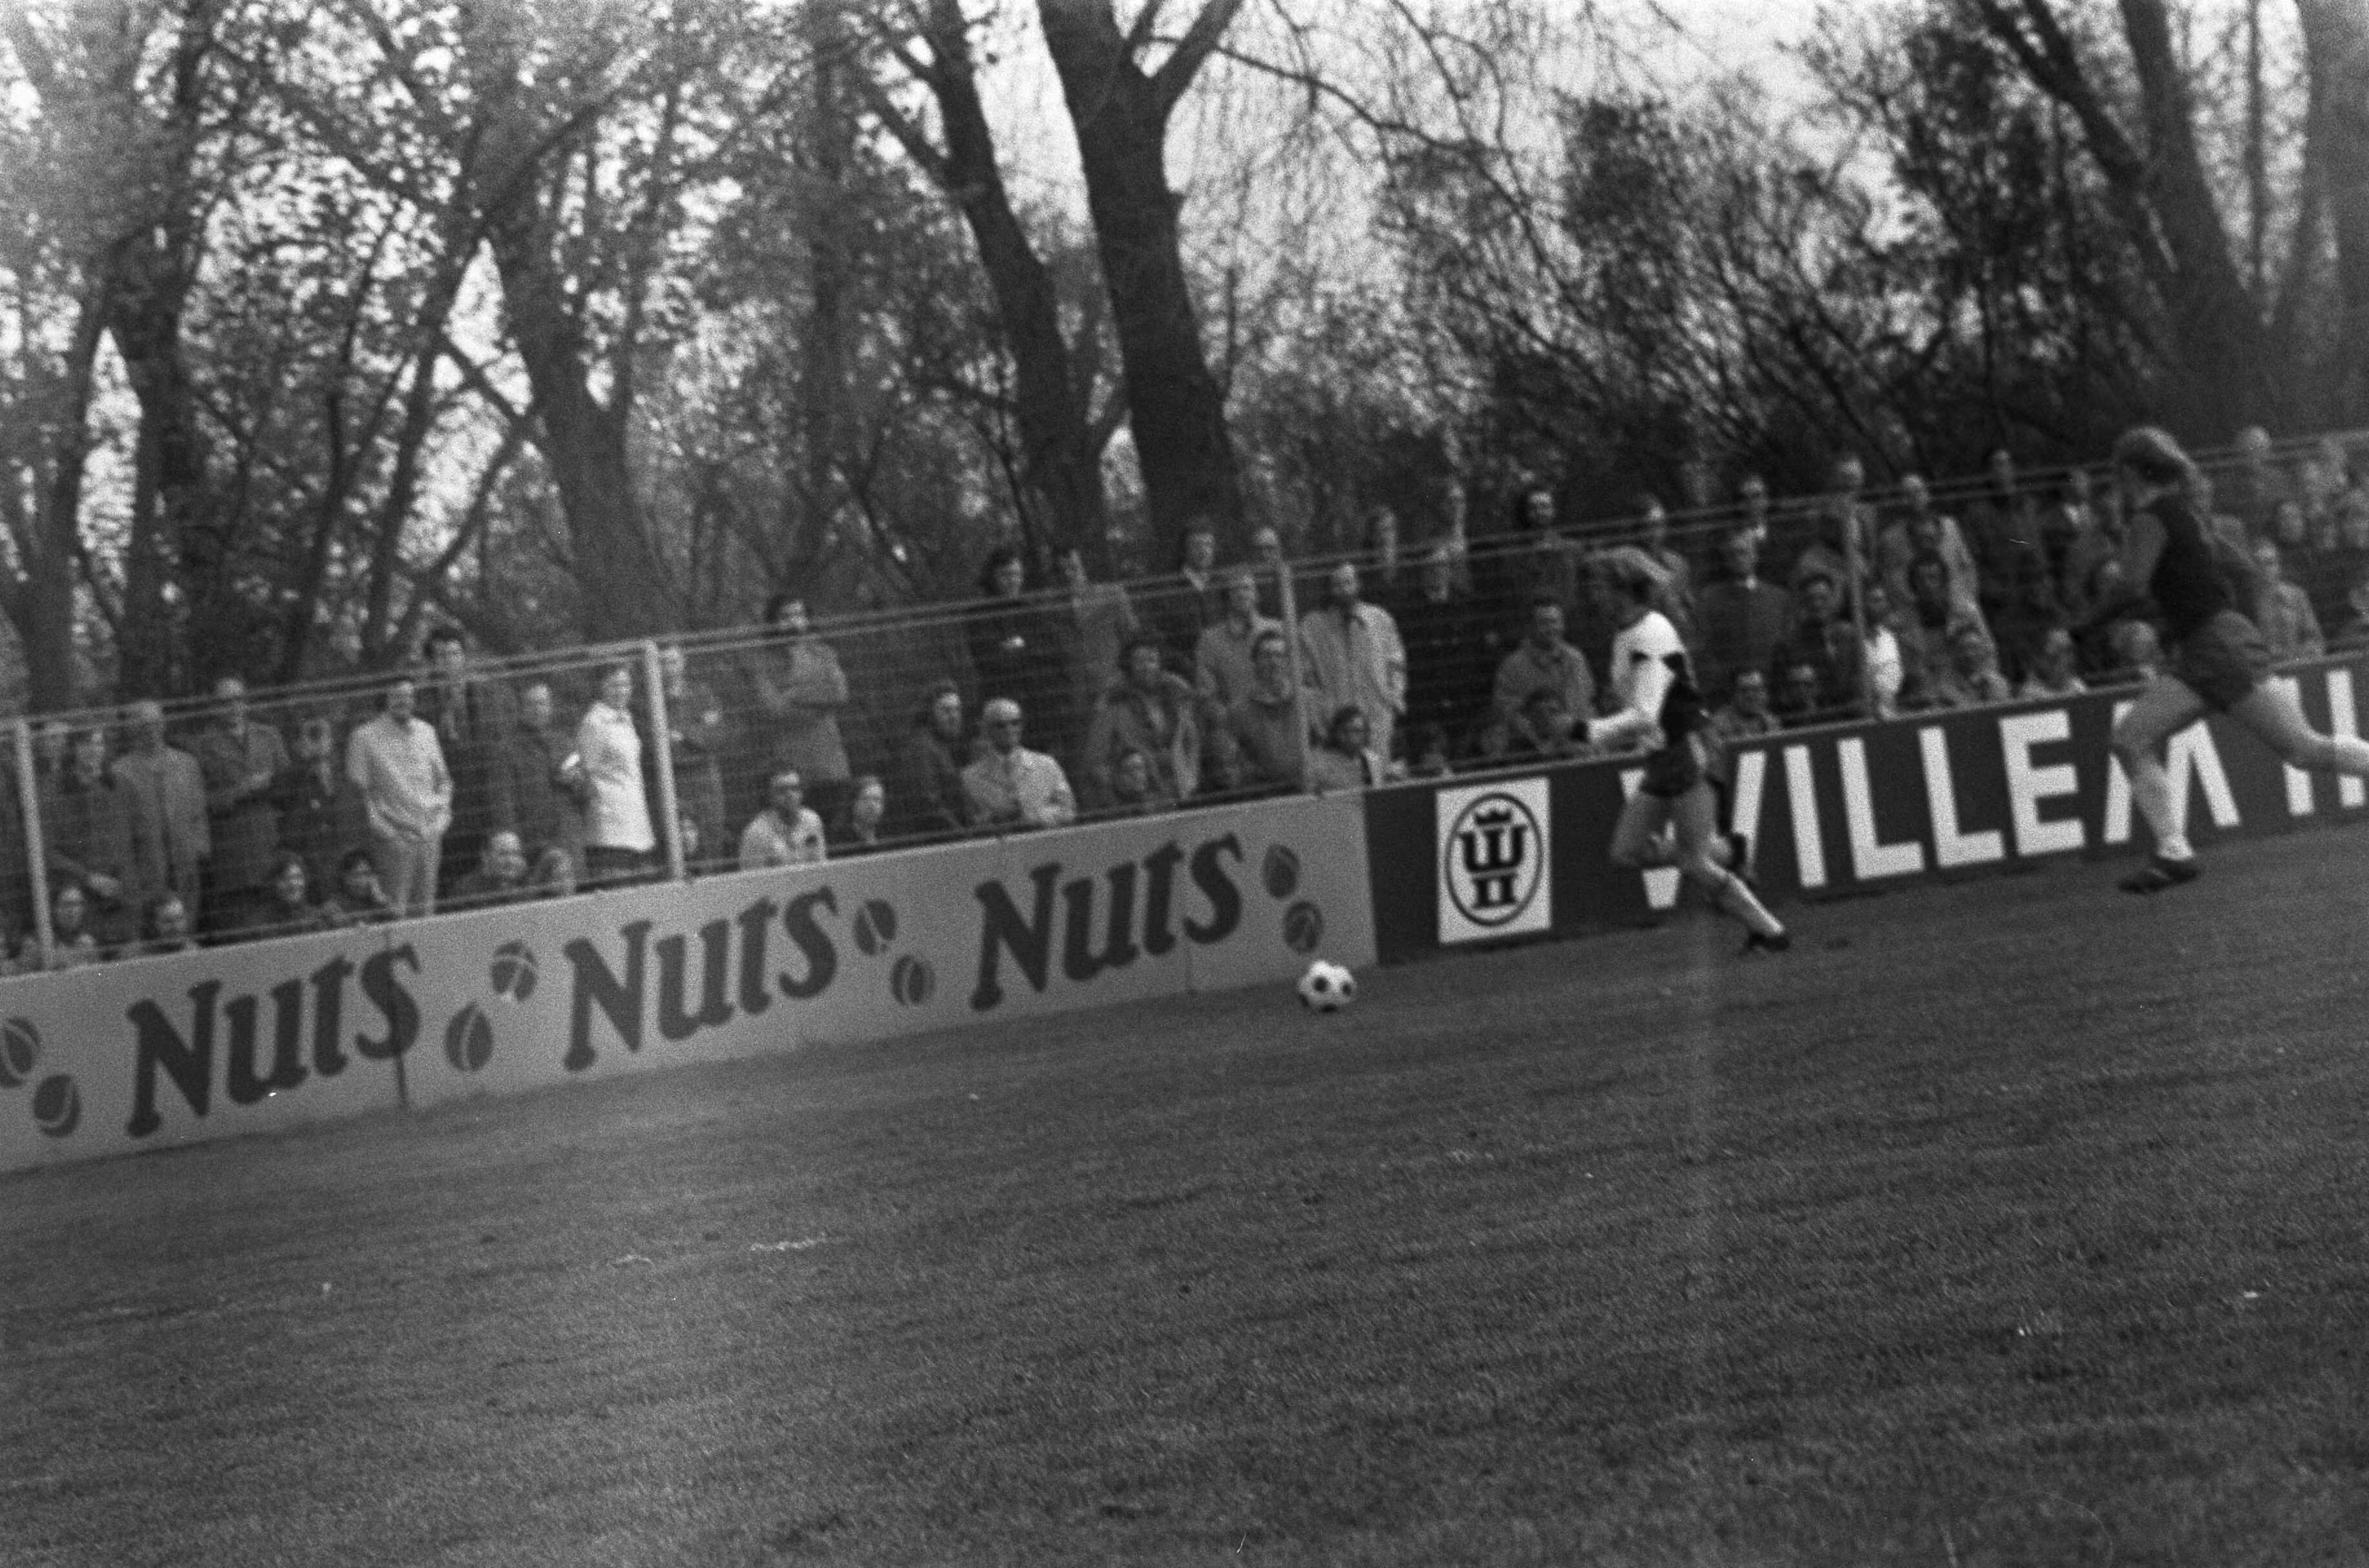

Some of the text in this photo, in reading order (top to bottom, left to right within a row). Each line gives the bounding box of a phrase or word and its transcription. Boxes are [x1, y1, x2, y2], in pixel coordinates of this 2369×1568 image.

[127, 832, 1244, 1138] Nuts Nuts Nuts
